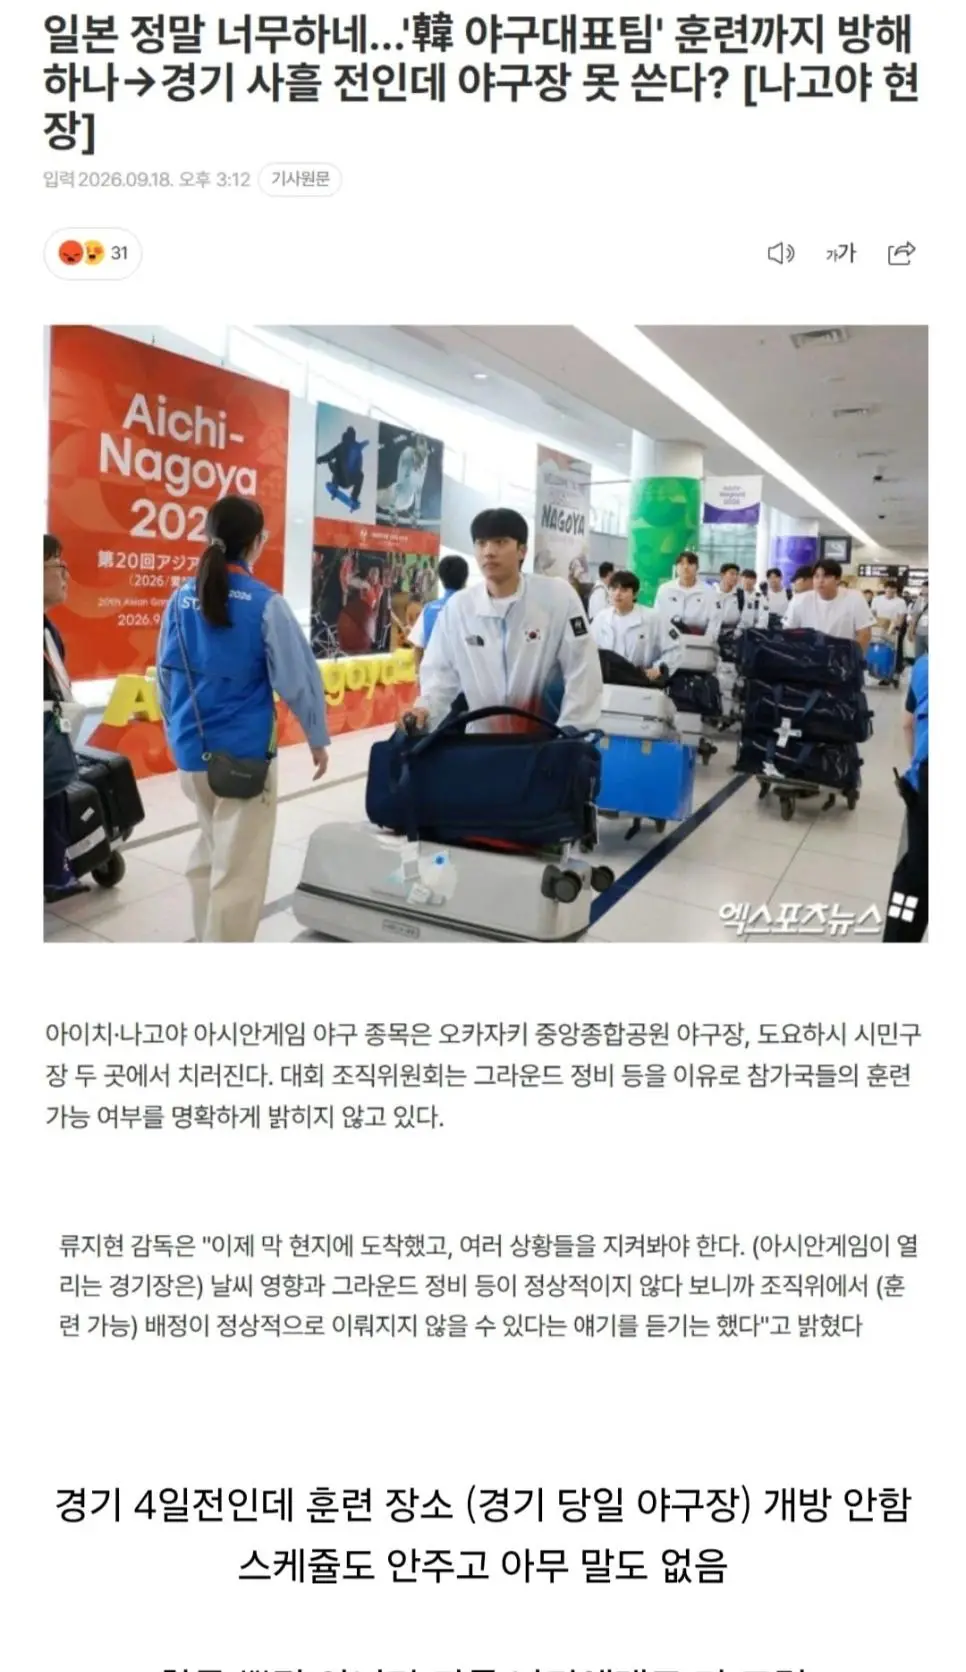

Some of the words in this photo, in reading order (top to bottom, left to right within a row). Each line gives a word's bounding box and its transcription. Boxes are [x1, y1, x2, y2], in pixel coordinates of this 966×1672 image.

[44, 14, 119, 54] 일본
[130, 14, 206, 54] 정말
[675, 14, 823, 54] 훈련까지
[839, 14, 911, 54] 방해
[247, 62, 322, 103] 사흘
[334, 62, 445, 103] 전인데
[458, 62, 572, 103] 야구장
[582, 63, 619, 102] 못
[631, 62, 729, 103] 쓴다?
[744, 62, 872, 105] [나고야
[883, 62, 918, 102] 현
[43, 110, 95, 156] 장]
[44, 172, 74, 187] 입력
[79, 172, 173, 186] 2026.09.18.
[181, 172, 209, 188] 오후
[217, 172, 249, 186] 3:12
[272, 171, 329, 186] 기사원문
[111, 246, 127, 260] 31
[122, 393, 244, 449] Aichi-
[100, 432, 257, 500] Nagoya
[129, 498, 208, 542] 202
[541, 504, 585, 537] NAGOYA
[118, 614, 160, 627] 2026.9
[194, 1022, 305, 1047] 아시안게임
[313, 1022, 358, 1047] 야구
[365, 1023, 432, 1047] 종목은
[439, 1022, 527, 1047] 오카자키
[535, 1022, 668, 1047] 중앙종합공원
[677, 1022, 749, 1049] 야구장,
[758, 1022, 846, 1047] 도요하시
[854, 1022, 921, 1047] 시민구
[60, 1234, 123, 1258] 류지현
[131, 1234, 196, 1258] 감독은
[262, 1234, 283, 1258] 막
[289, 1234, 353, 1258] 현지에
[361, 1234, 452, 1260] 도착했고,
[460, 1234, 501, 1258] 여러
[510, 1234, 596, 1258] 상황들을
[603, 1234, 690, 1258] 지켜봐야
[696, 1234, 744, 1258] 한다.
[753, 1234, 889, 1260] (아시안게임이
[897, 1234, 917, 1258] 열
[56, 1487, 119, 1523] 경기
[134, 1487, 292, 1523] 4일전인데
[306, 1487, 372, 1523] 훈련
[386, 1487, 453, 1523] 장소
[467, 1484, 543, 1524] (경기
[559, 1487, 623, 1523] 당일
[638, 1484, 750, 1524] 야구장)
[764, 1487, 832, 1523] 개방
[844, 1487, 912, 1523] 안함
